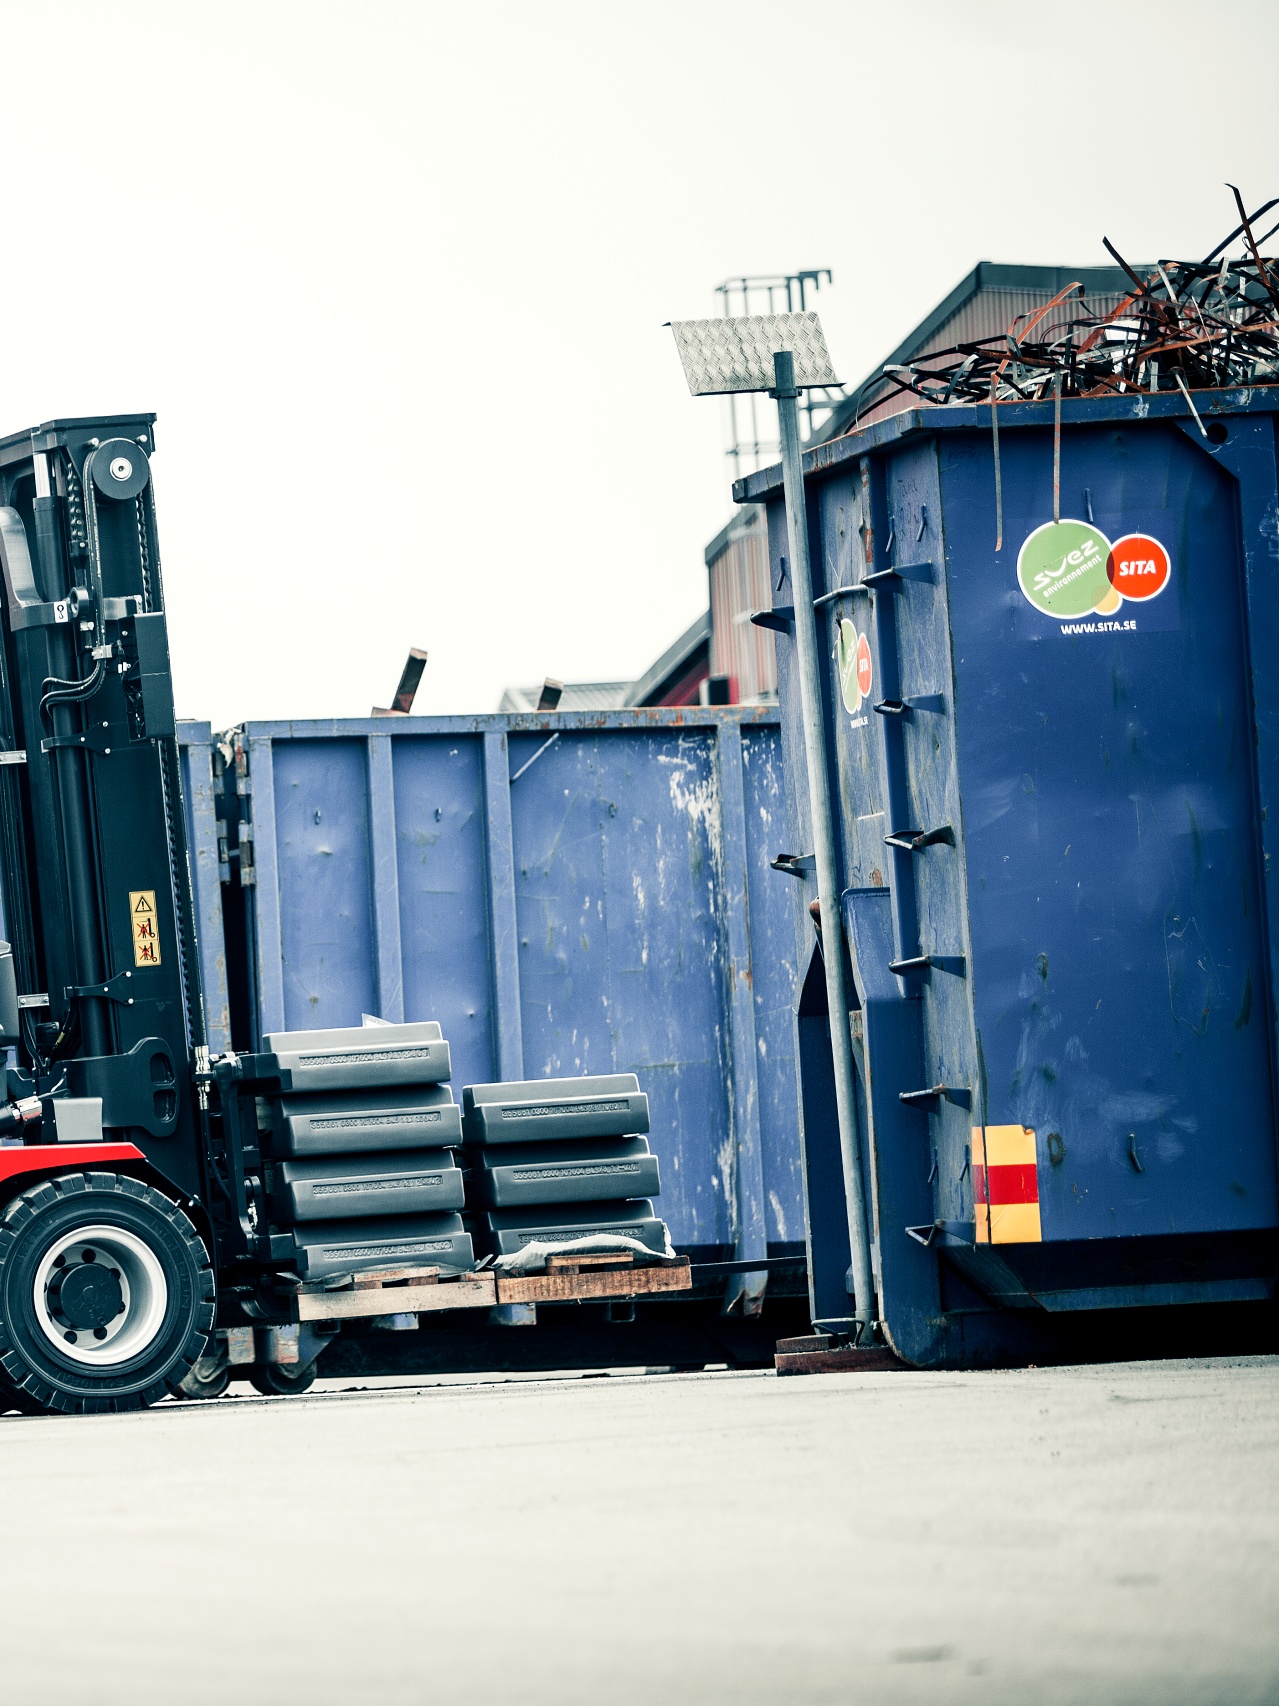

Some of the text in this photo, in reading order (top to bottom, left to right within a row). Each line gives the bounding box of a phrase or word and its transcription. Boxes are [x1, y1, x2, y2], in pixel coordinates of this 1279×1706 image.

[1043, 554, 1102, 598] environnement
[1119, 559, 1156, 576] SITA
[1060, 620, 1137, 635] WWW.SITA.SE
